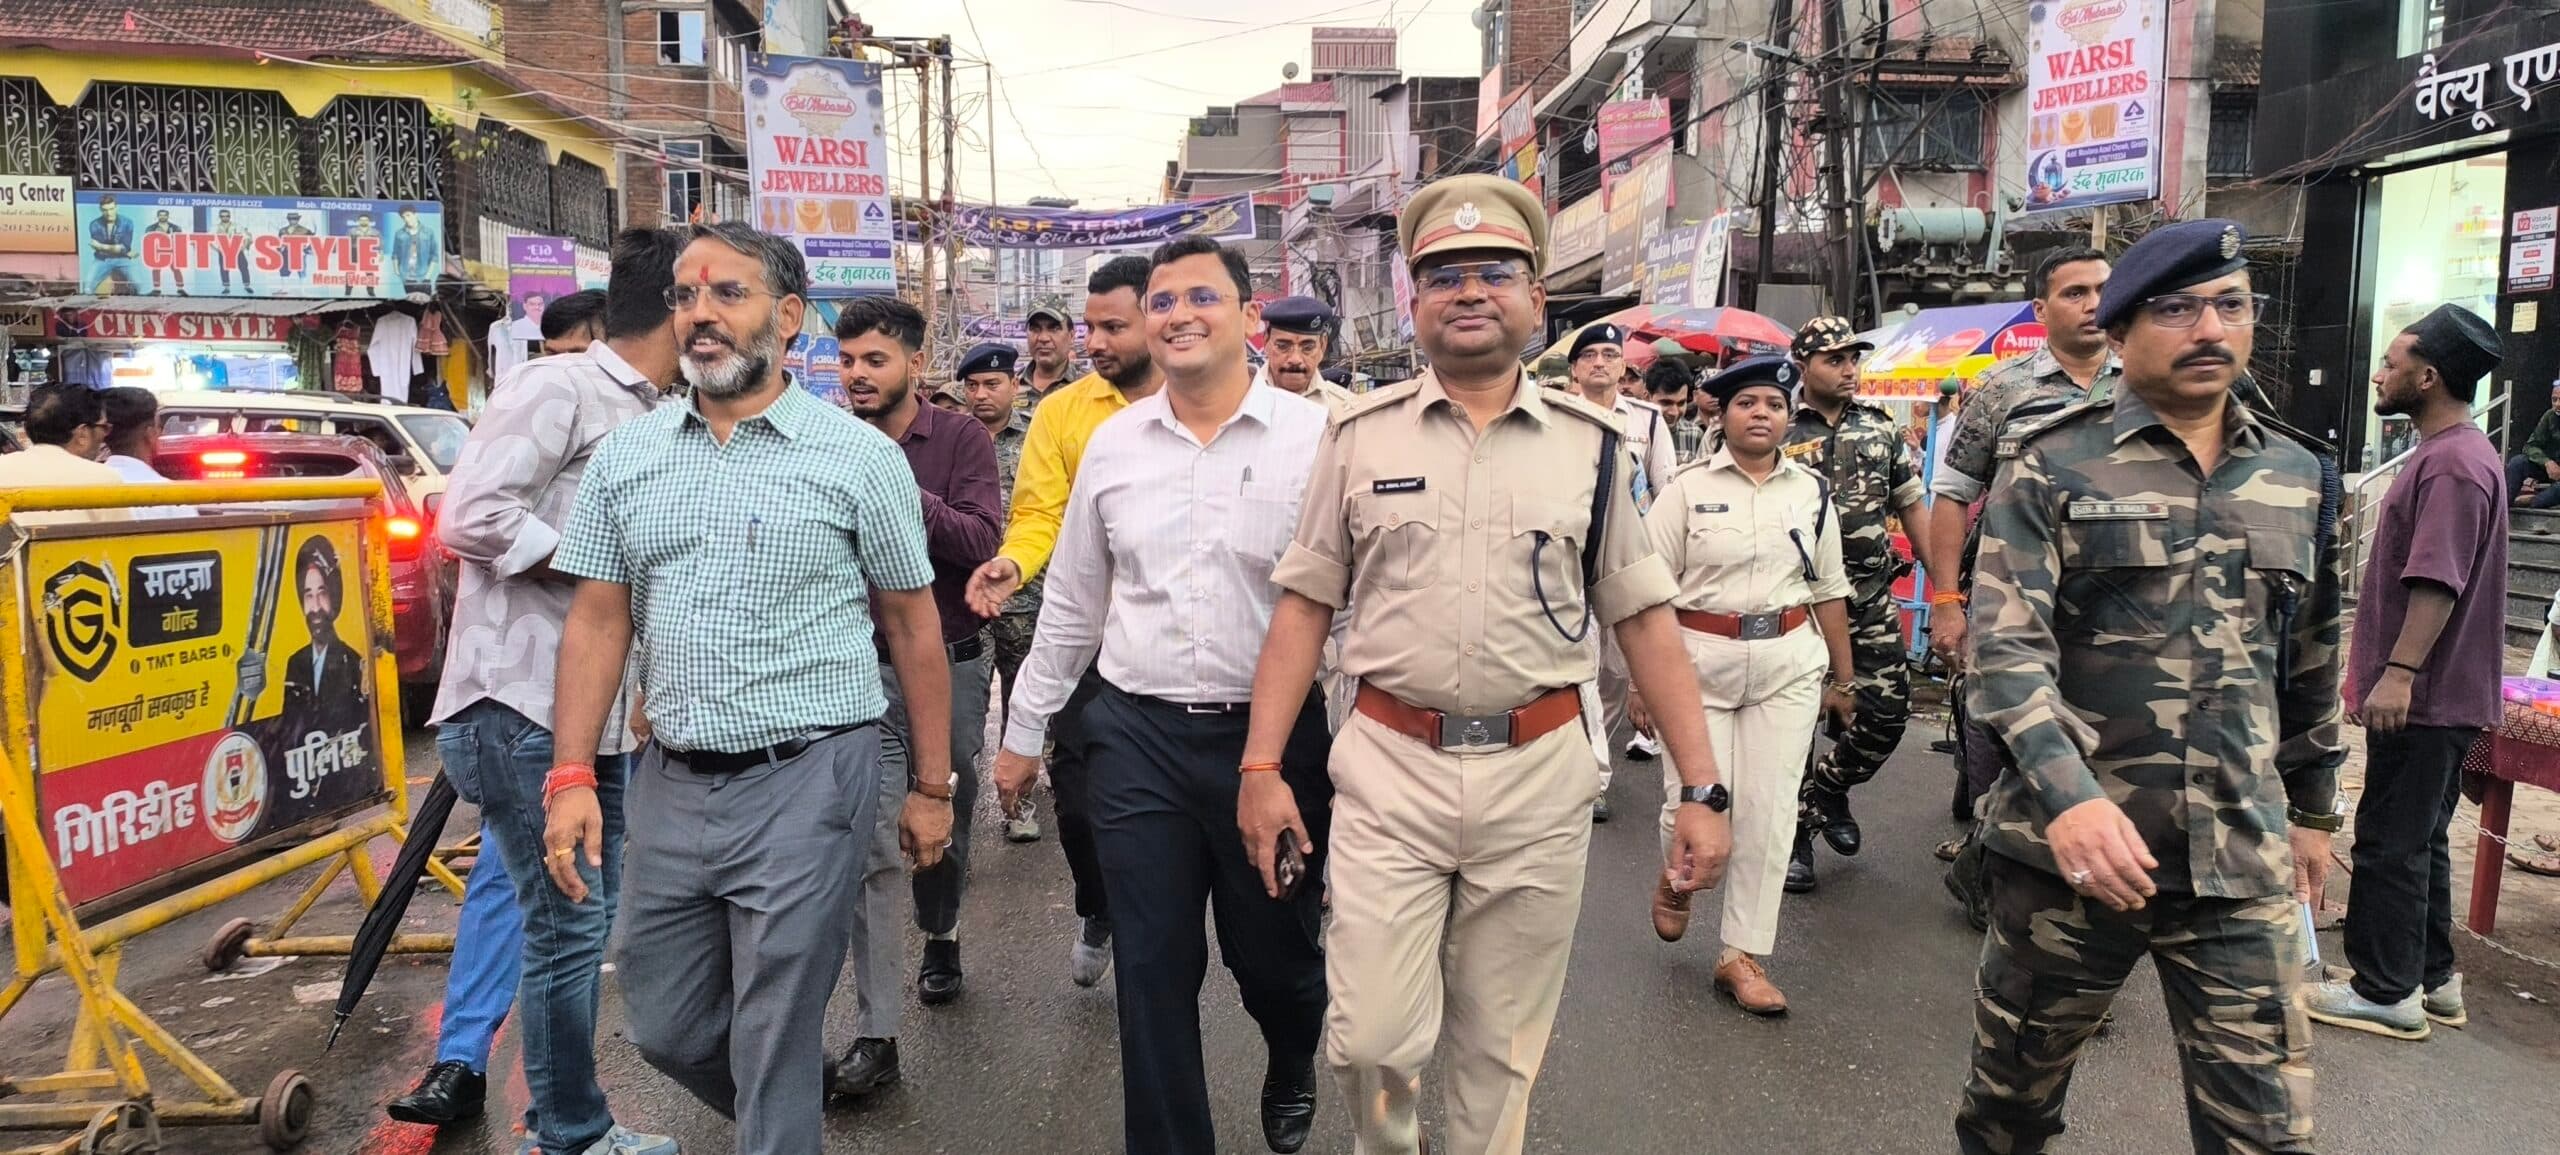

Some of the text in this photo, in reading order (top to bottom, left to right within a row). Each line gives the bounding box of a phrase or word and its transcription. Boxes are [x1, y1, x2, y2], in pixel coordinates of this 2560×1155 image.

[2047, 38, 2135, 81] WARSI
[2033, 70, 2148, 112] JEWELLERS
[2415, 53, 2495, 131] वैल्यू
[773, 136, 870, 168] WARSI
[19, 182, 65, 203] Center
[762, 170, 884, 196] JEWELLERS
[2072, 166, 2146, 192] ईद मुबारक
[143, 231, 379, 272] CITY STYLE
[313, 273, 380, 287] Mens Wear
[815, 260, 892, 287] ईद मुबारक
[95, 311, 276, 341] CITY STYLE
[136, 558, 217, 600] सलूजा
[161, 606, 199, 633] गोल्ड
[146, 647, 217, 671] TMT BARS
[148, 688, 198, 723] सबकुछ
[199, 680, 211, 707] है
[54, 780, 198, 869] गिरिडीह
